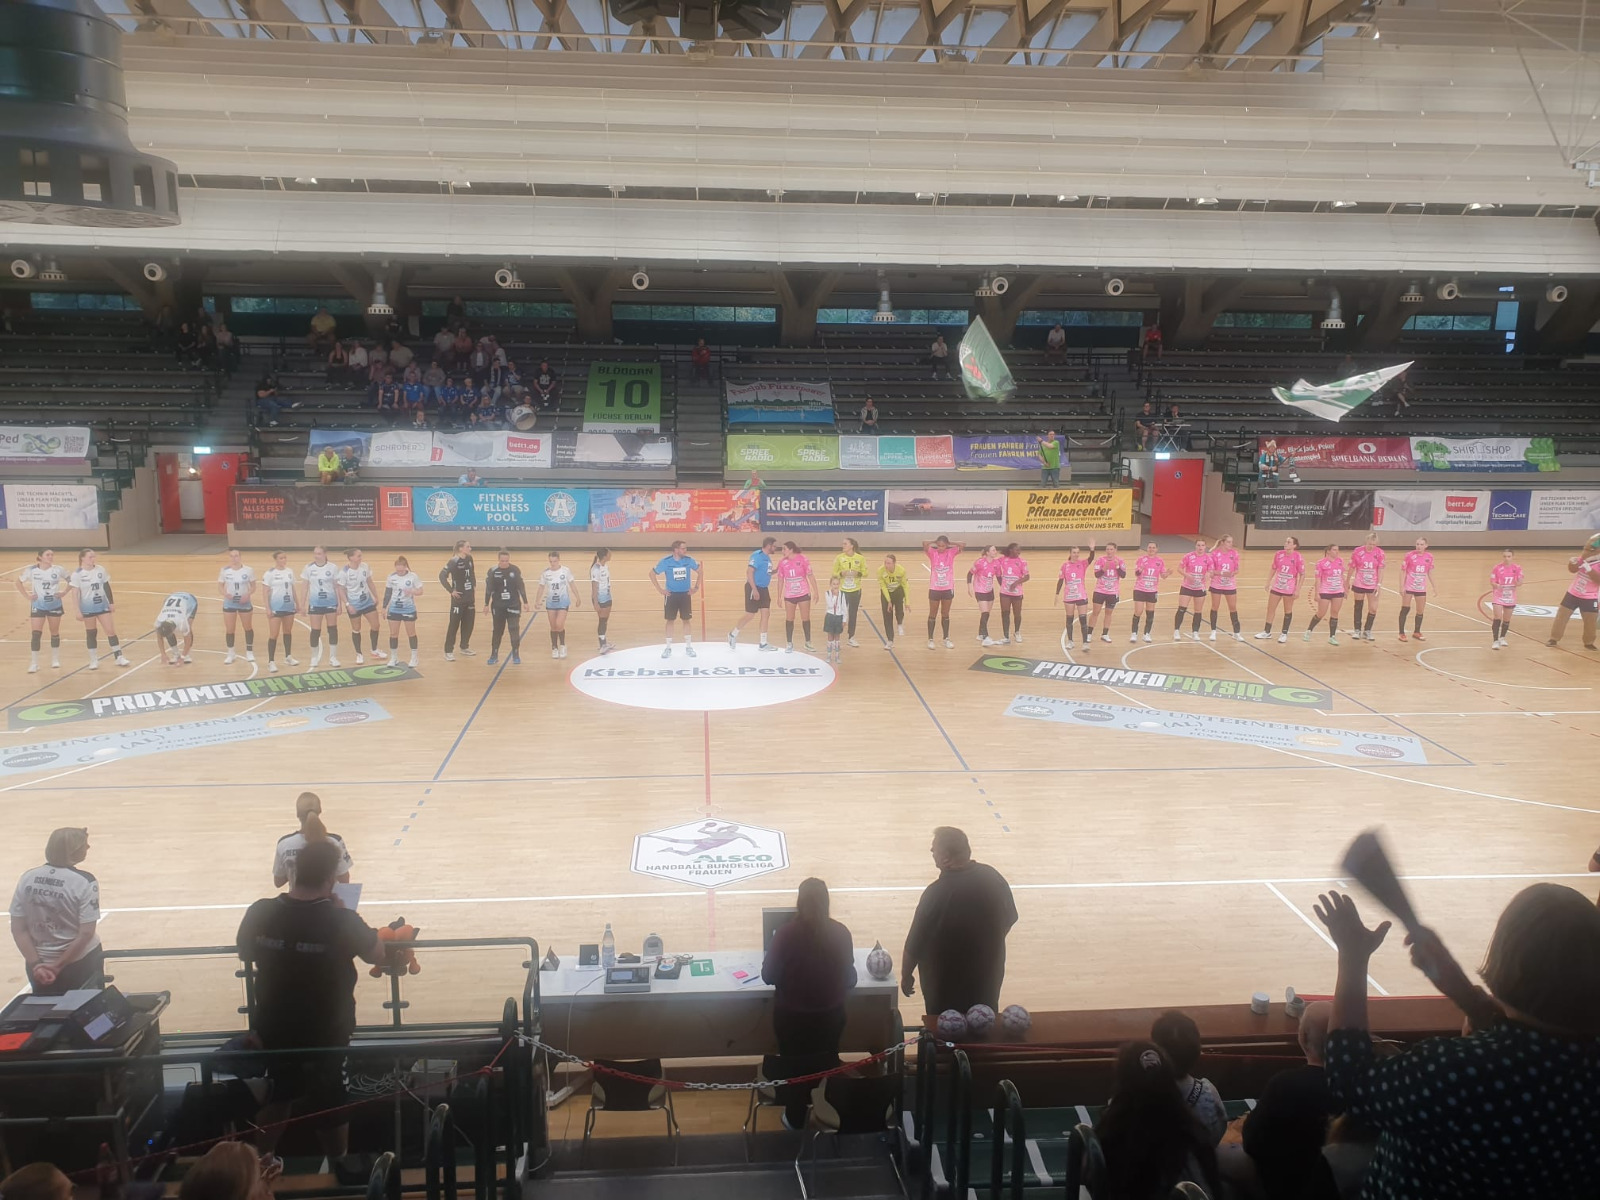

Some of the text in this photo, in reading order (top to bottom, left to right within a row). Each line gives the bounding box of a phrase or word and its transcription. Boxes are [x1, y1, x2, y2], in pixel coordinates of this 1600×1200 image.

[599, 379, 651, 408] 10
[970, 443, 997, 451] FRAUEN
[998, 442, 1025, 450] FAHREN
[1485, 446, 1512, 455] SHOP
[999, 450, 1026, 458] FAHREN
[1331, 454, 1408, 463] SPIELBANK BERLIN
[259, 497, 285, 505] HABEN
[478, 493, 525, 503] FITNESS
[1027, 491, 1113, 504] Der Holländer
[473, 503, 530, 513] WELLNESS
[766, 496, 879, 511] Kieback&Peter
[1447, 500, 1476, 508] bett1.de
[267, 505, 285, 513] FEST
[1027, 506, 1112, 517] Pflanzencenter
[243, 512, 252, 520] IM
[486, 513, 518, 522] POOL
[1075, 521, 1094, 529] GRÜN
[584, 666, 820, 677] Kieback&Peter
[692, 854, 773, 864] ALSCO
[706, 862, 775, 870] BUNDESLIGA
